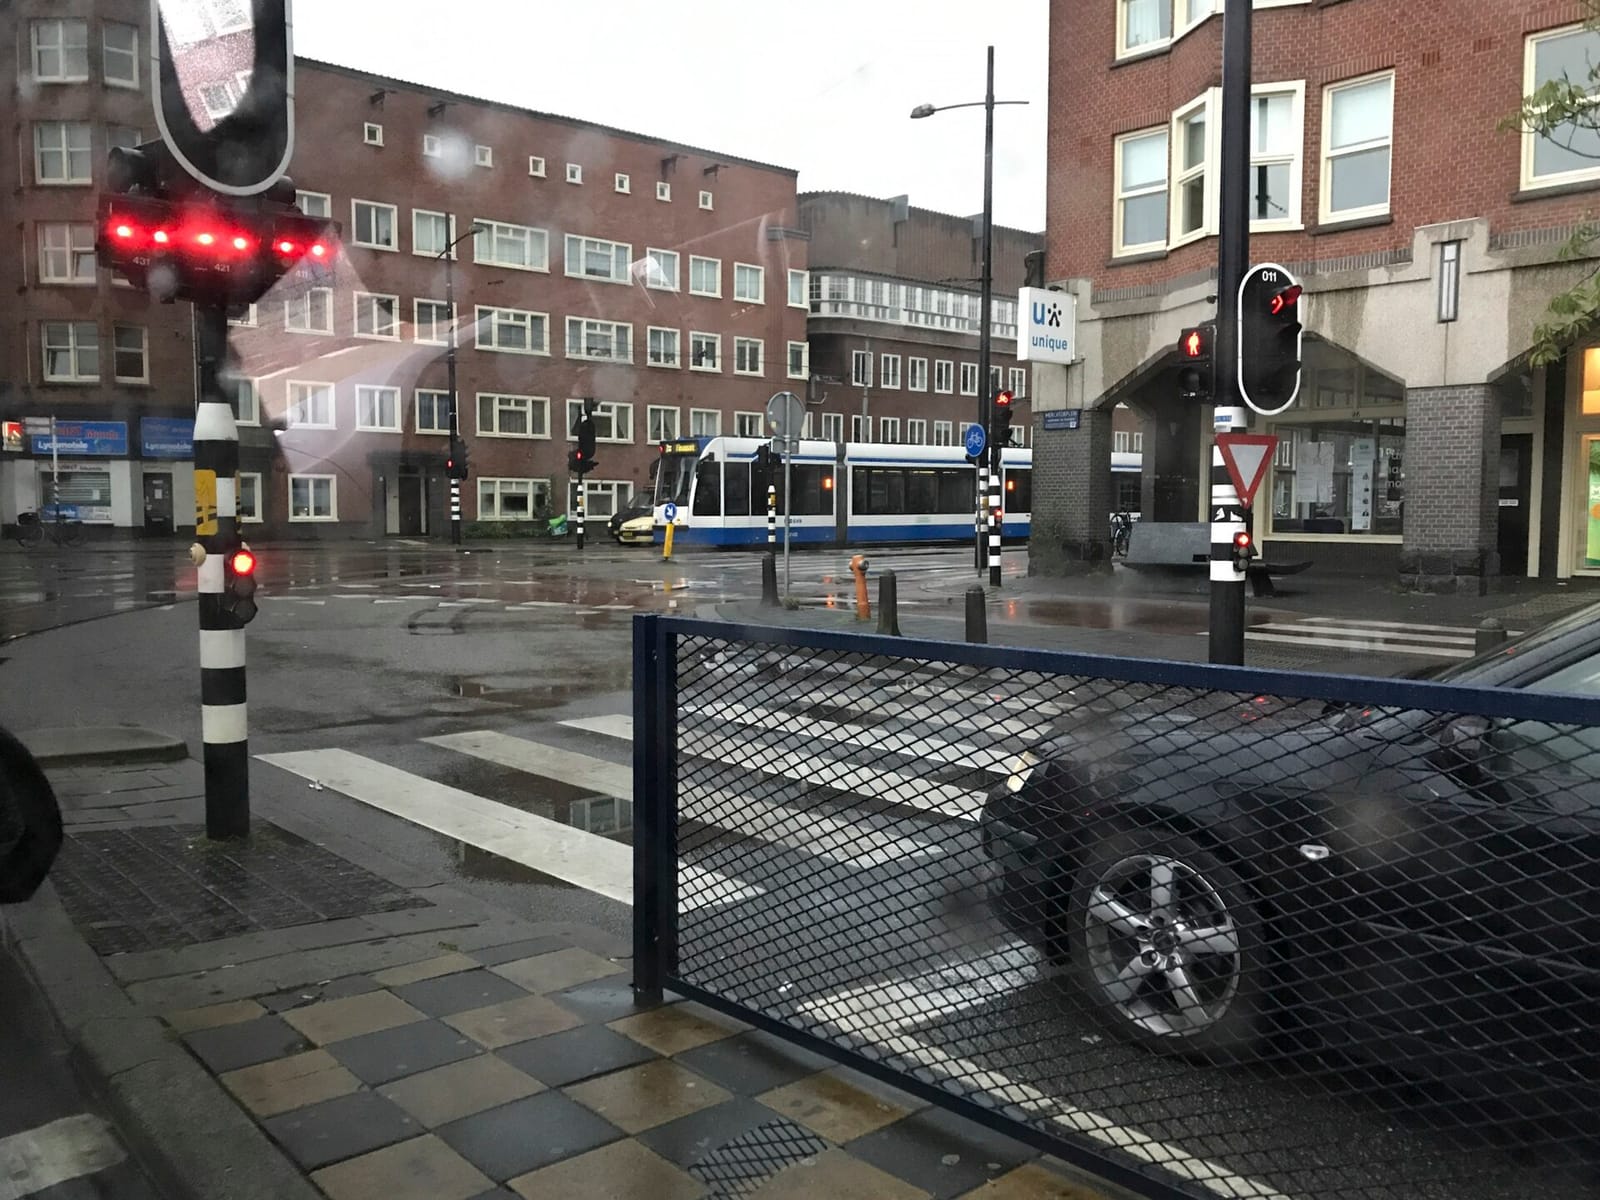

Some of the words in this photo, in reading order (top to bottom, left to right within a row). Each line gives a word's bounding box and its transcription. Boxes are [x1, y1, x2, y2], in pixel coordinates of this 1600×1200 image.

[132, 256, 150, 265] 431
[213, 263, 230, 272] 421
[1261, 270, 1277, 282] 011
[1032, 334, 1068, 352] unique
[38, 439, 88, 450] Lycmobile
